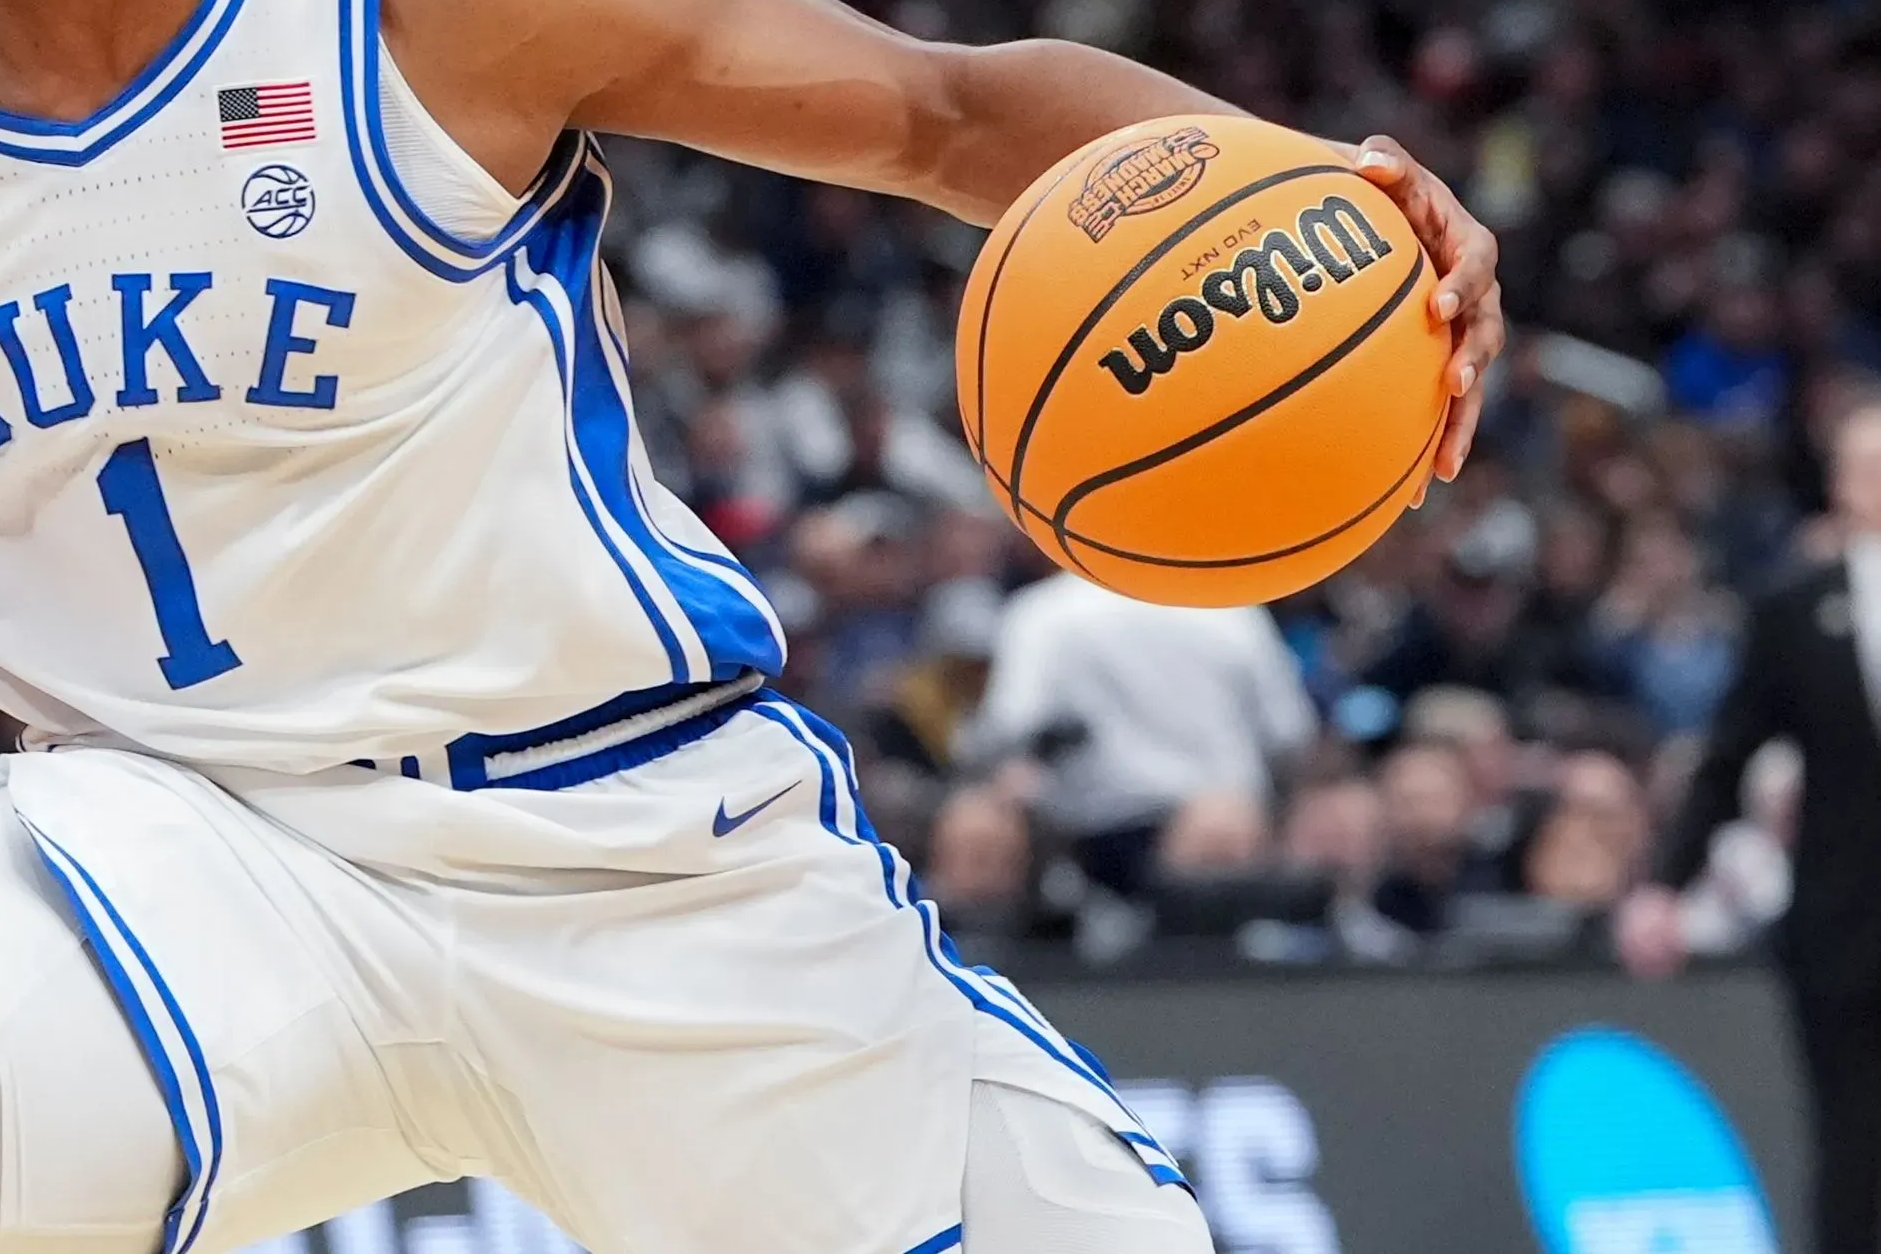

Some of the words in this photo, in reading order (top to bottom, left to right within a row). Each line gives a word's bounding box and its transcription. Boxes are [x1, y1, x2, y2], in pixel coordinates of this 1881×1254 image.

[252, 186, 310, 208] ACC
[1069, 143, 1170, 227] MADNESS
[1116, 150, 1197, 207] MARCH
[1222, 219, 1262, 249] EVO
[1181, 248, 1220, 281] NXT
[1098, 195, 1393, 396] Wilson
[96, 437, 244, 690] 1
